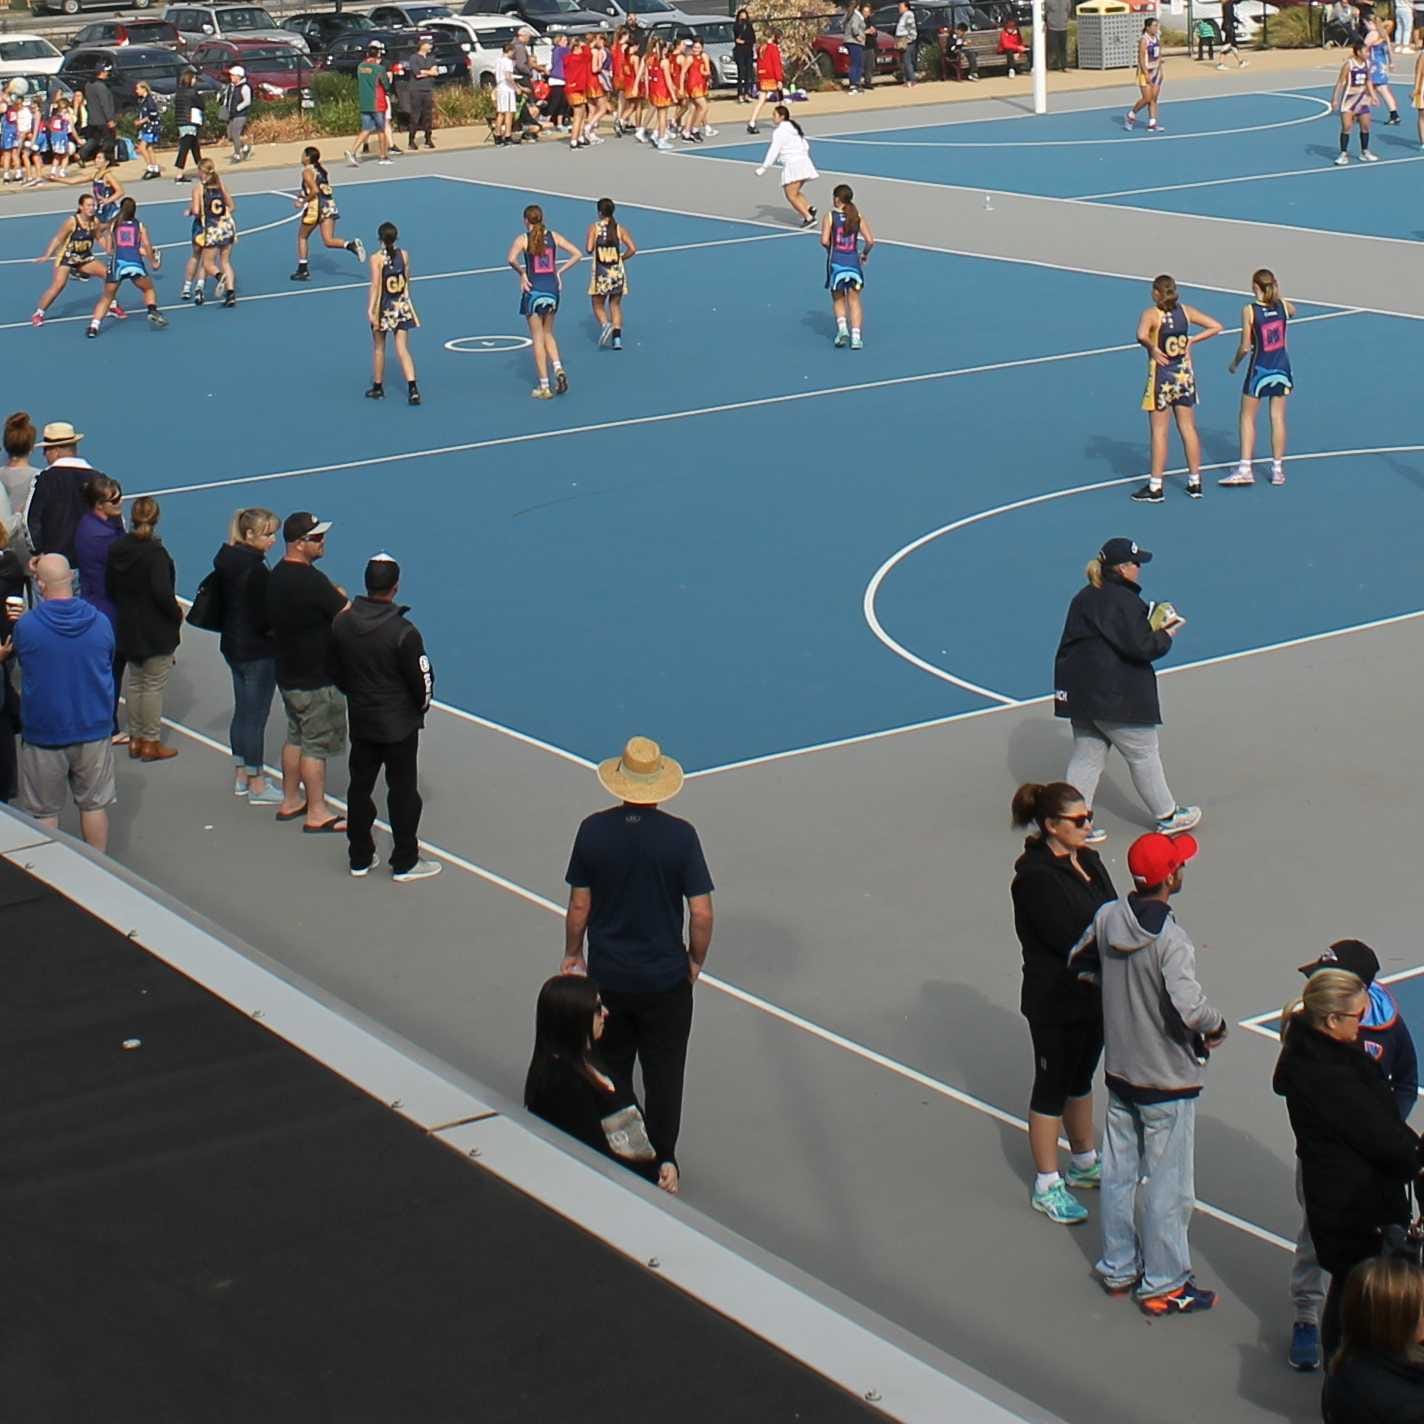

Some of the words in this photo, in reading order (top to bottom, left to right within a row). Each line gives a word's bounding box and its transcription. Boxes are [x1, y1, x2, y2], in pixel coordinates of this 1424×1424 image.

[210, 198, 224, 215] C
[598, 246, 618, 263] WA
[1165, 334, 1188, 358] GS
